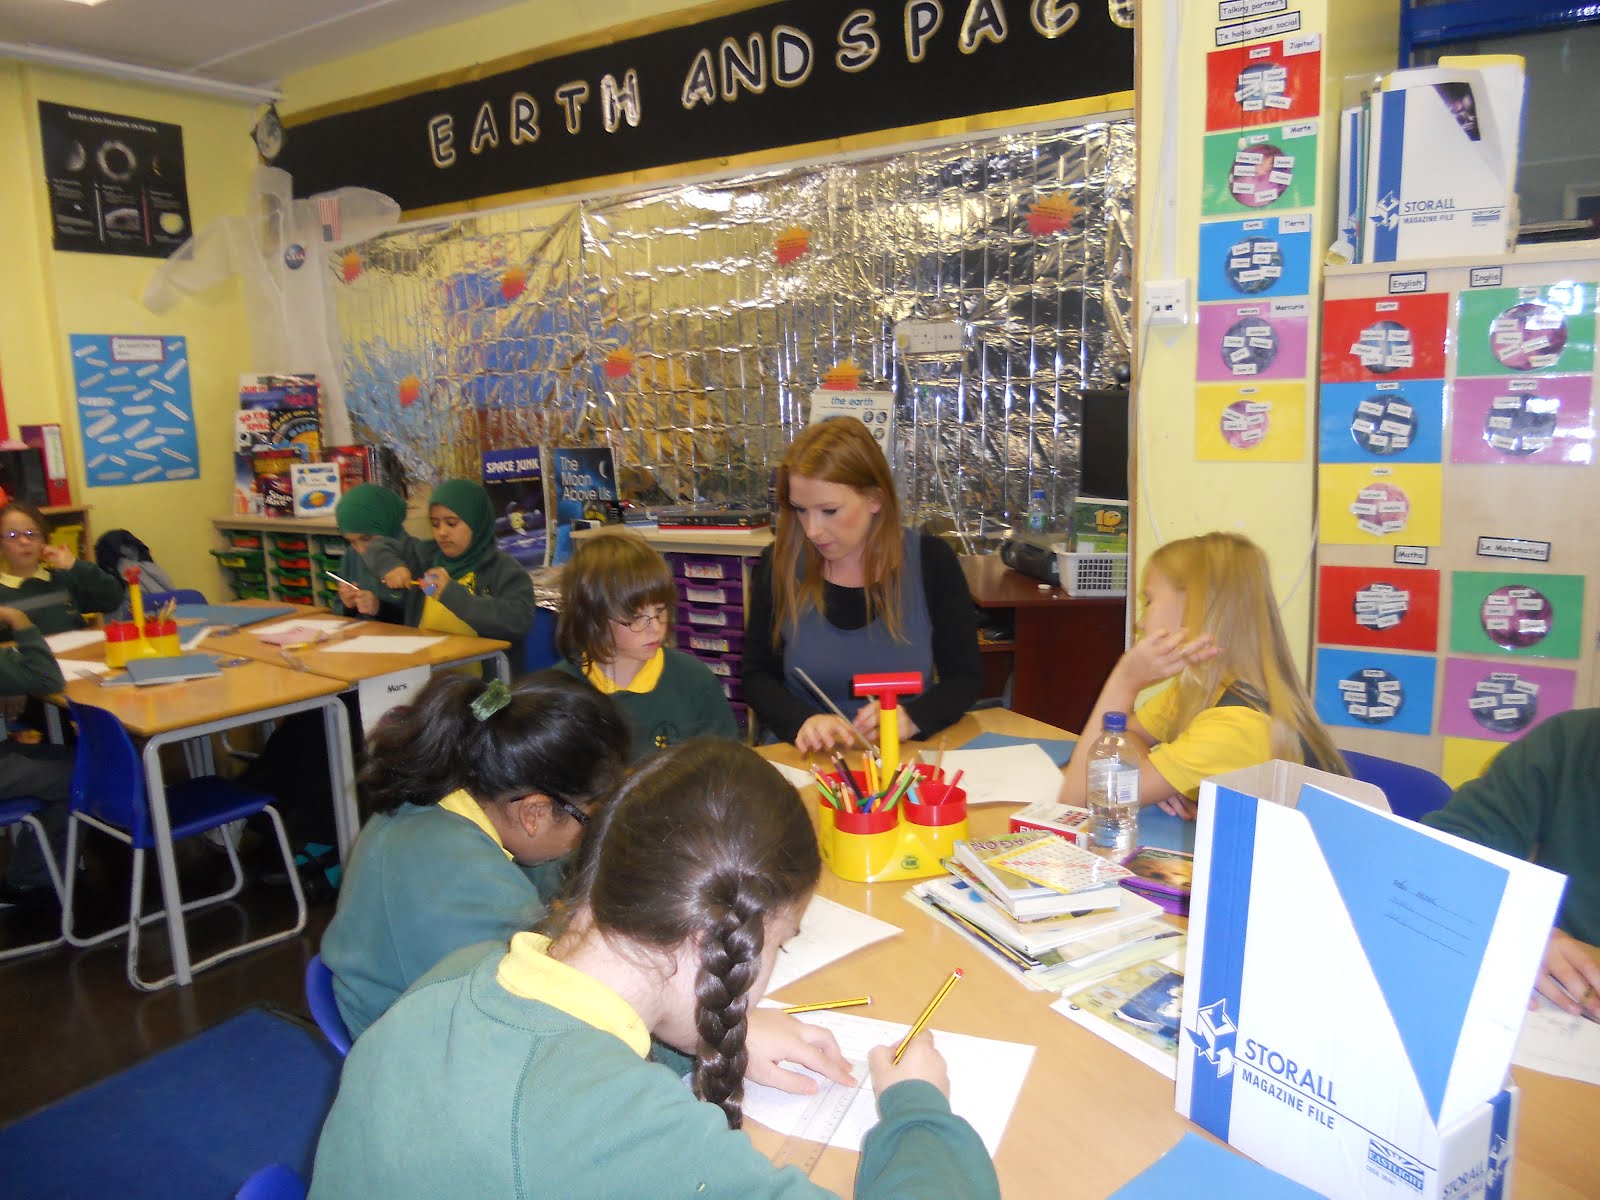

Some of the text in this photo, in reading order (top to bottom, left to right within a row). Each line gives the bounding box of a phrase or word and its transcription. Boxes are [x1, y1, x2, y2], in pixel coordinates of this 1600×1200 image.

[1222, 4, 1249, 14] Talking
[1276, 18, 1298, 29] social
[1289, 40, 1315, 50] Jupiter
[428, 68, 643, 169] EARTH
[681, 24, 814, 110] AND
[1290, 125, 1311, 133] Marte
[1404, 198, 1456, 213] STORALL
[1403, 213, 1455, 224] MAGAZINE FILE
[1393, 279, 1422, 289] English
[1474, 274, 1499, 283] Inglis
[831, 397, 874, 406] the earth
[486, 458, 540, 473] SPACE JUNK
[560, 456, 579, 471] The
[561, 473, 592, 486] Moon
[562, 486, 612, 501] Above Us
[1481, 543, 1491, 551] Le
[1398, 550, 1424, 559] Maths
[387, 683, 408, 693] Mars
[1243, 1038, 1337, 1107] STORALL
[1242, 1068, 1335, 1130] MAGAZINE FILE
[1368, 1150, 1424, 1191] EASTLIGHT
